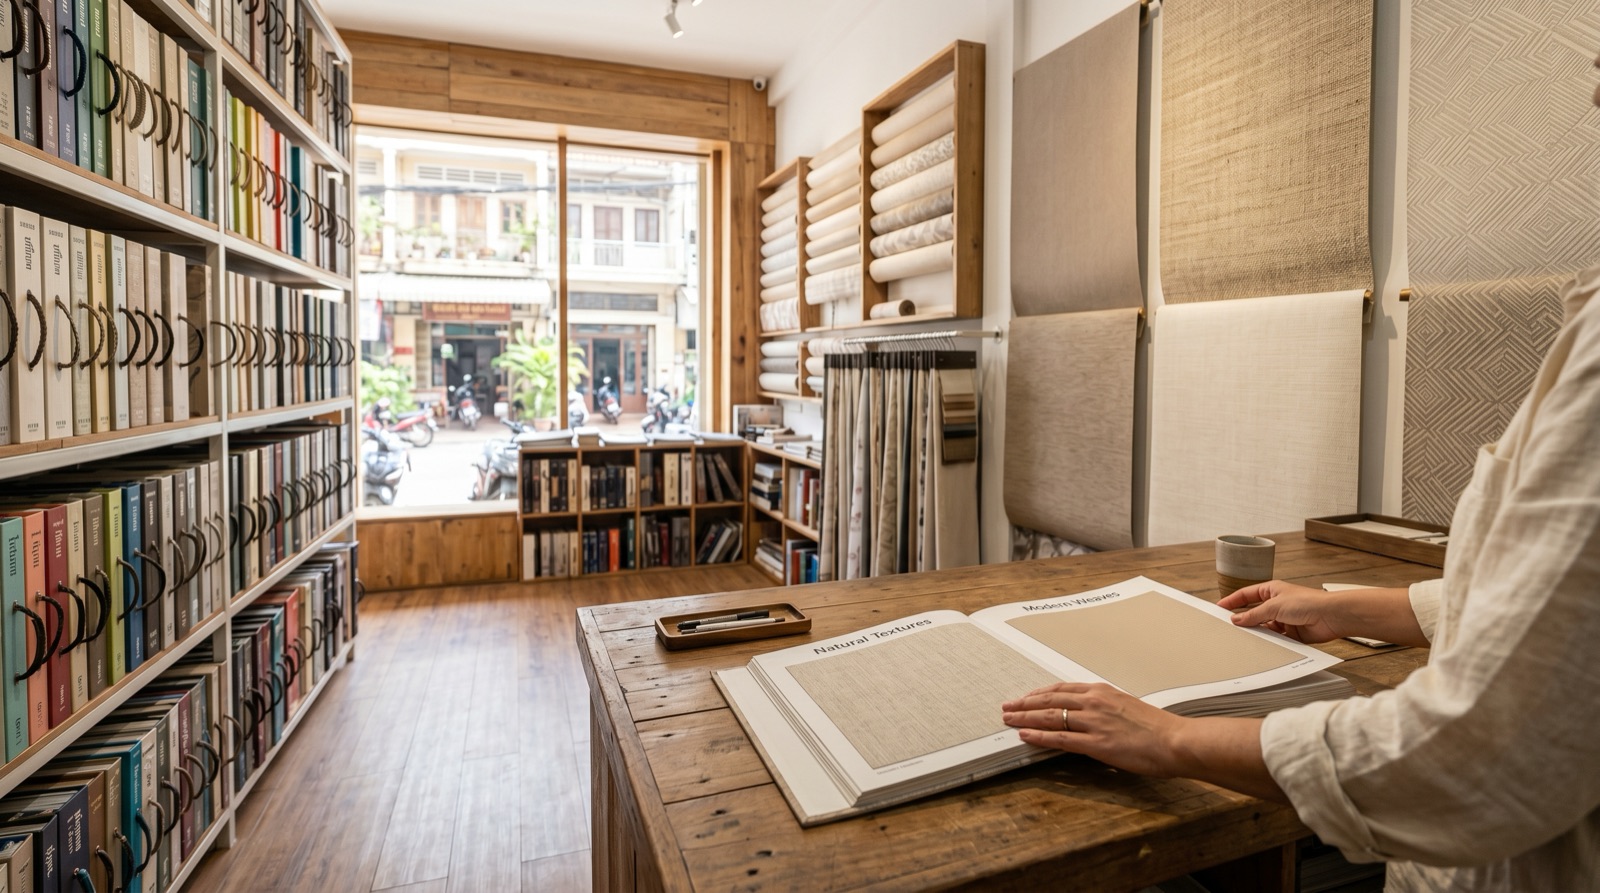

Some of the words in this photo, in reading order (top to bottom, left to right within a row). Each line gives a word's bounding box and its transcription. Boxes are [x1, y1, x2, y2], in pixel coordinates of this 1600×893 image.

[1022, 602, 1073, 612] Modern
[1070, 591, 1120, 605] Weaves
[813, 635, 869, 655] Natural
[870, 619, 932, 639] Textures
